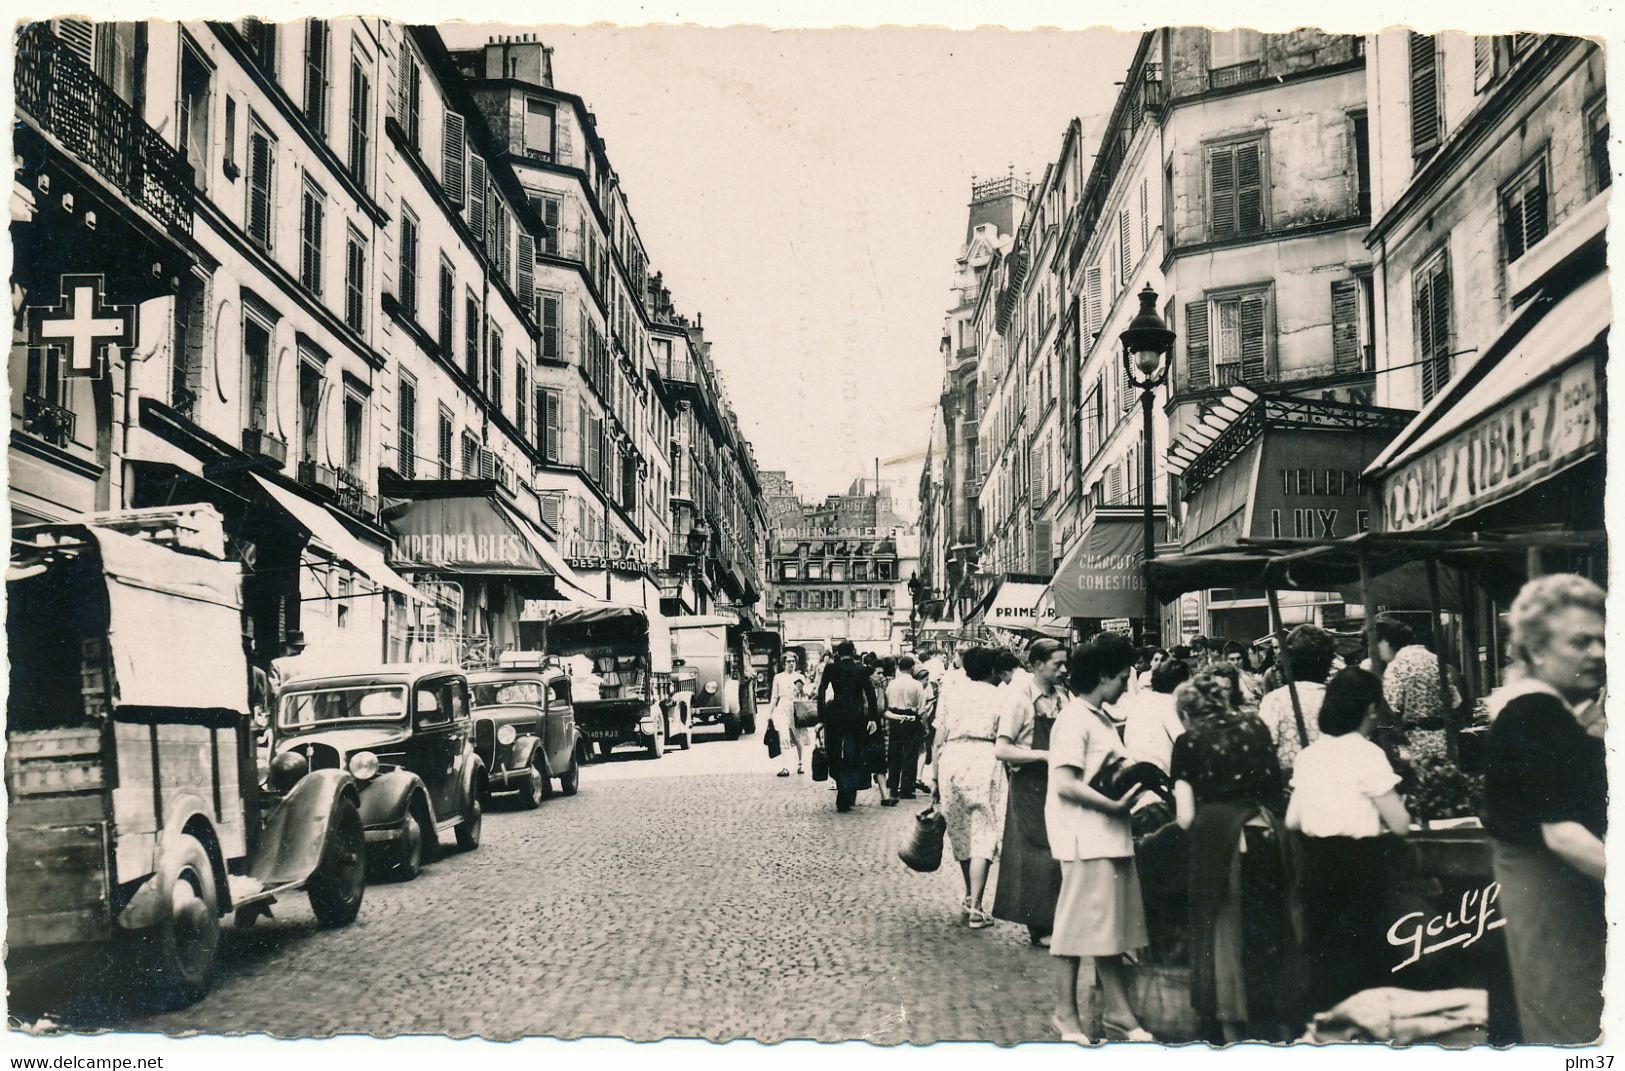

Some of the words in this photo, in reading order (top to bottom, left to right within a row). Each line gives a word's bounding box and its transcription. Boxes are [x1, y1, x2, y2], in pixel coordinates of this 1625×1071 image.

[1280, 468, 1366, 496] TELEP
[572, 559, 594, 568] DES
[1078, 574, 1147, 591] COMESTIBL
